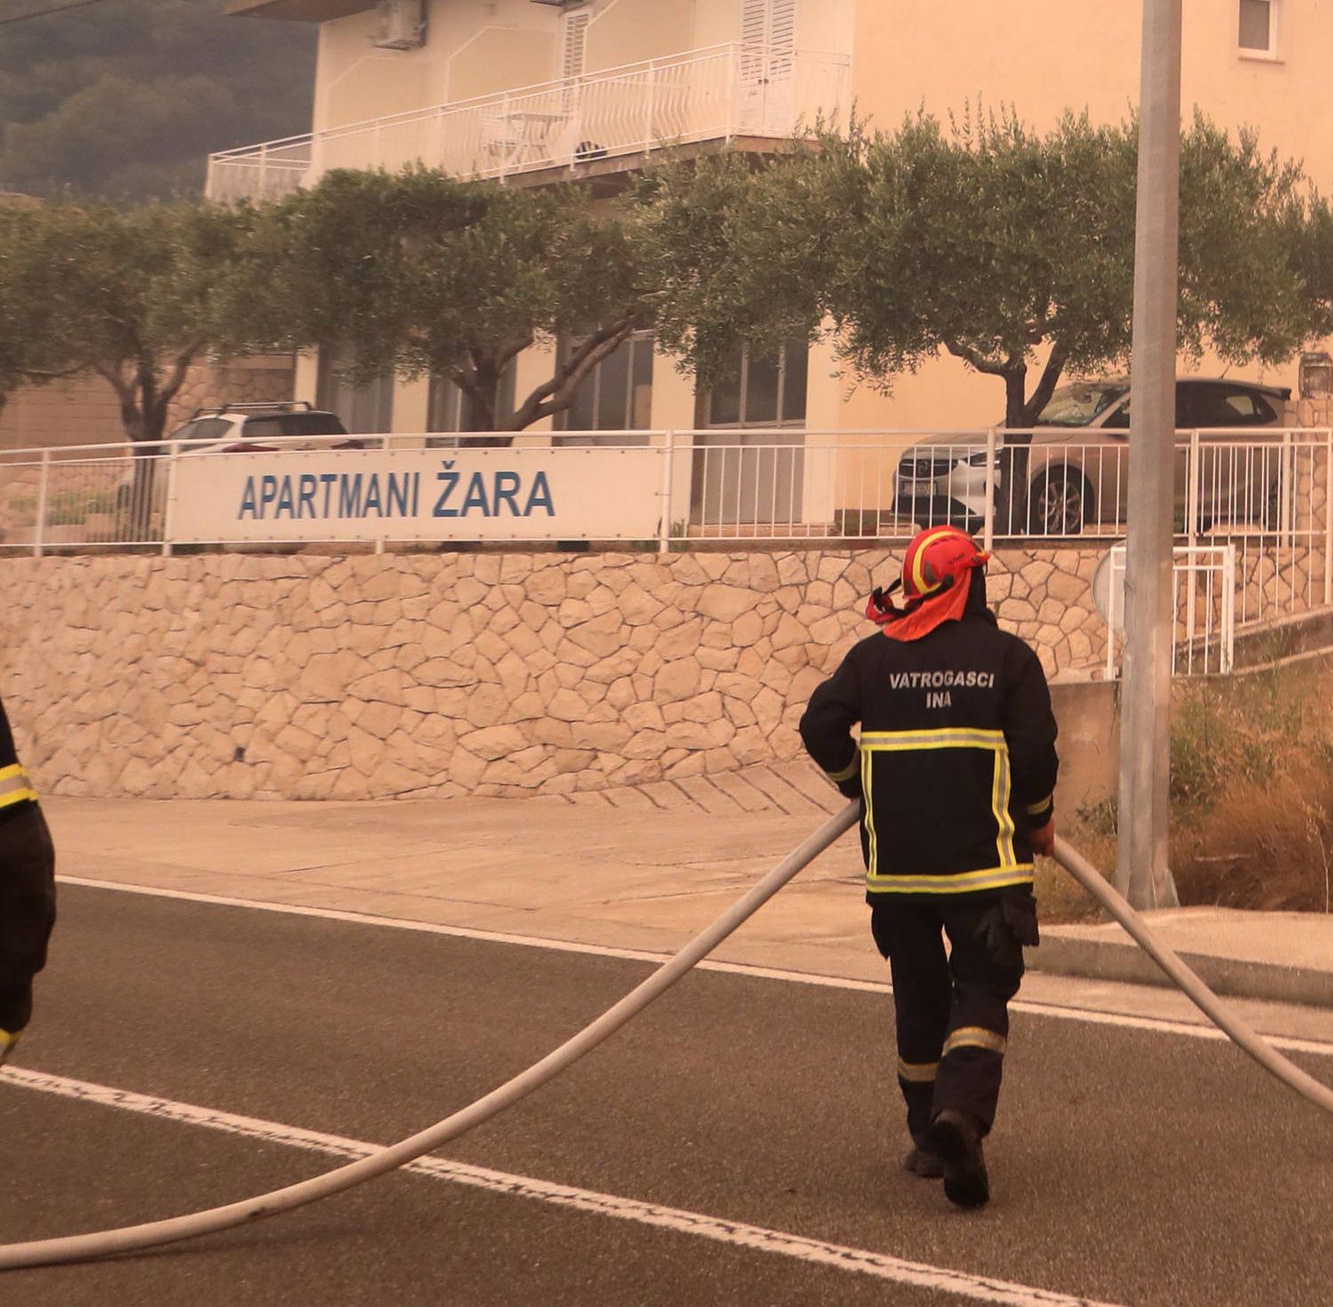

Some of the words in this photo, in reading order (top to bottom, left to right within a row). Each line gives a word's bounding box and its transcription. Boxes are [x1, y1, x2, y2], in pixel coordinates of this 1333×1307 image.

[238, 472, 420, 520] APARTMANI
[433, 460, 555, 517] ŽARA
[889, 670, 995, 690] VATROGASCI
[926, 691, 952, 709] INA
